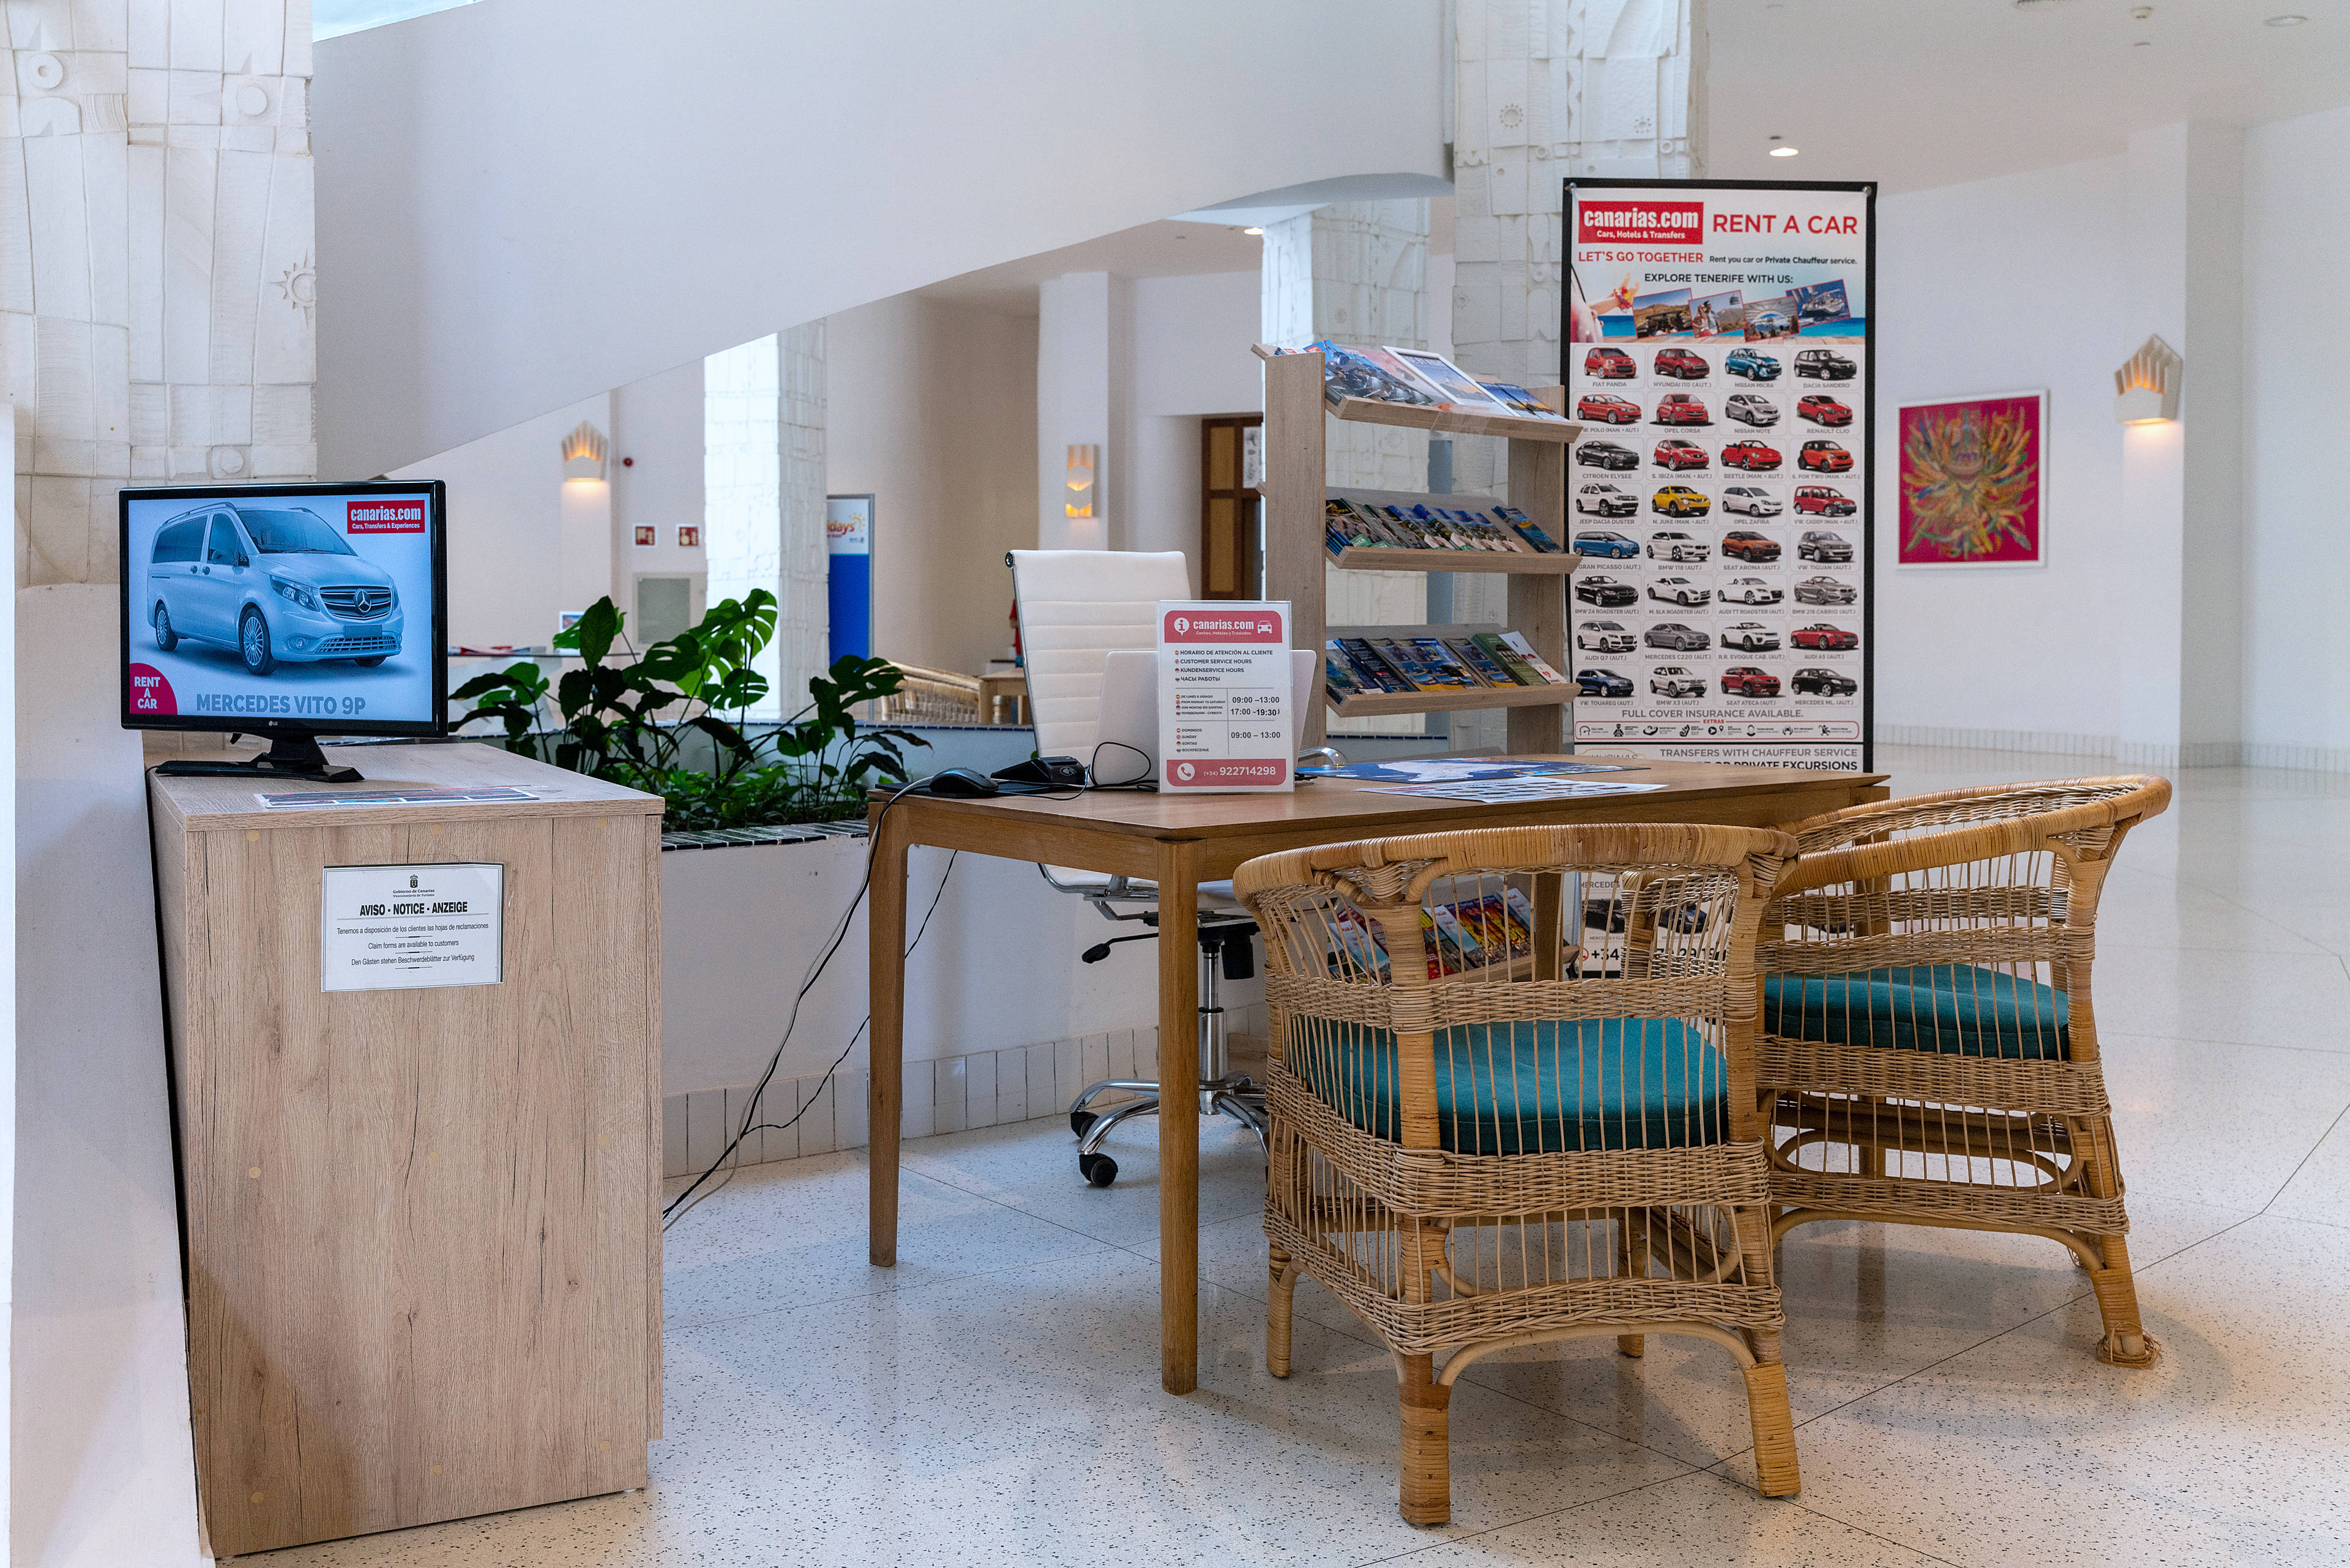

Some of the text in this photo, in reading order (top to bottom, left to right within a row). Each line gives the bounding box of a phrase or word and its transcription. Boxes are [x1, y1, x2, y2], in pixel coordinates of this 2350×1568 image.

[1584, 207, 1698, 228] canarias.com
[1714, 214, 1857, 234] RENT A CAR
[1579, 252, 1703, 262] LET'S GO TOGETHER
[1645, 274, 1691, 282] EXPLORE
[1695, 274, 1744, 283] TENERIFE
[351, 506, 420, 521] canarias.com
[1193, 619, 1253, 629] canarias.com
[135, 677, 160, 689] RENT
[144, 688, 151, 698] A
[138, 698, 157, 709] CAR
[196, 694, 366, 715] MERCEDES VITO 9P
[1220, 767, 1275, 775] 922714298
[360, 902, 467, 916] AVISO NOTICE ANZEIGE
[364, 926, 391, 935] disposición
